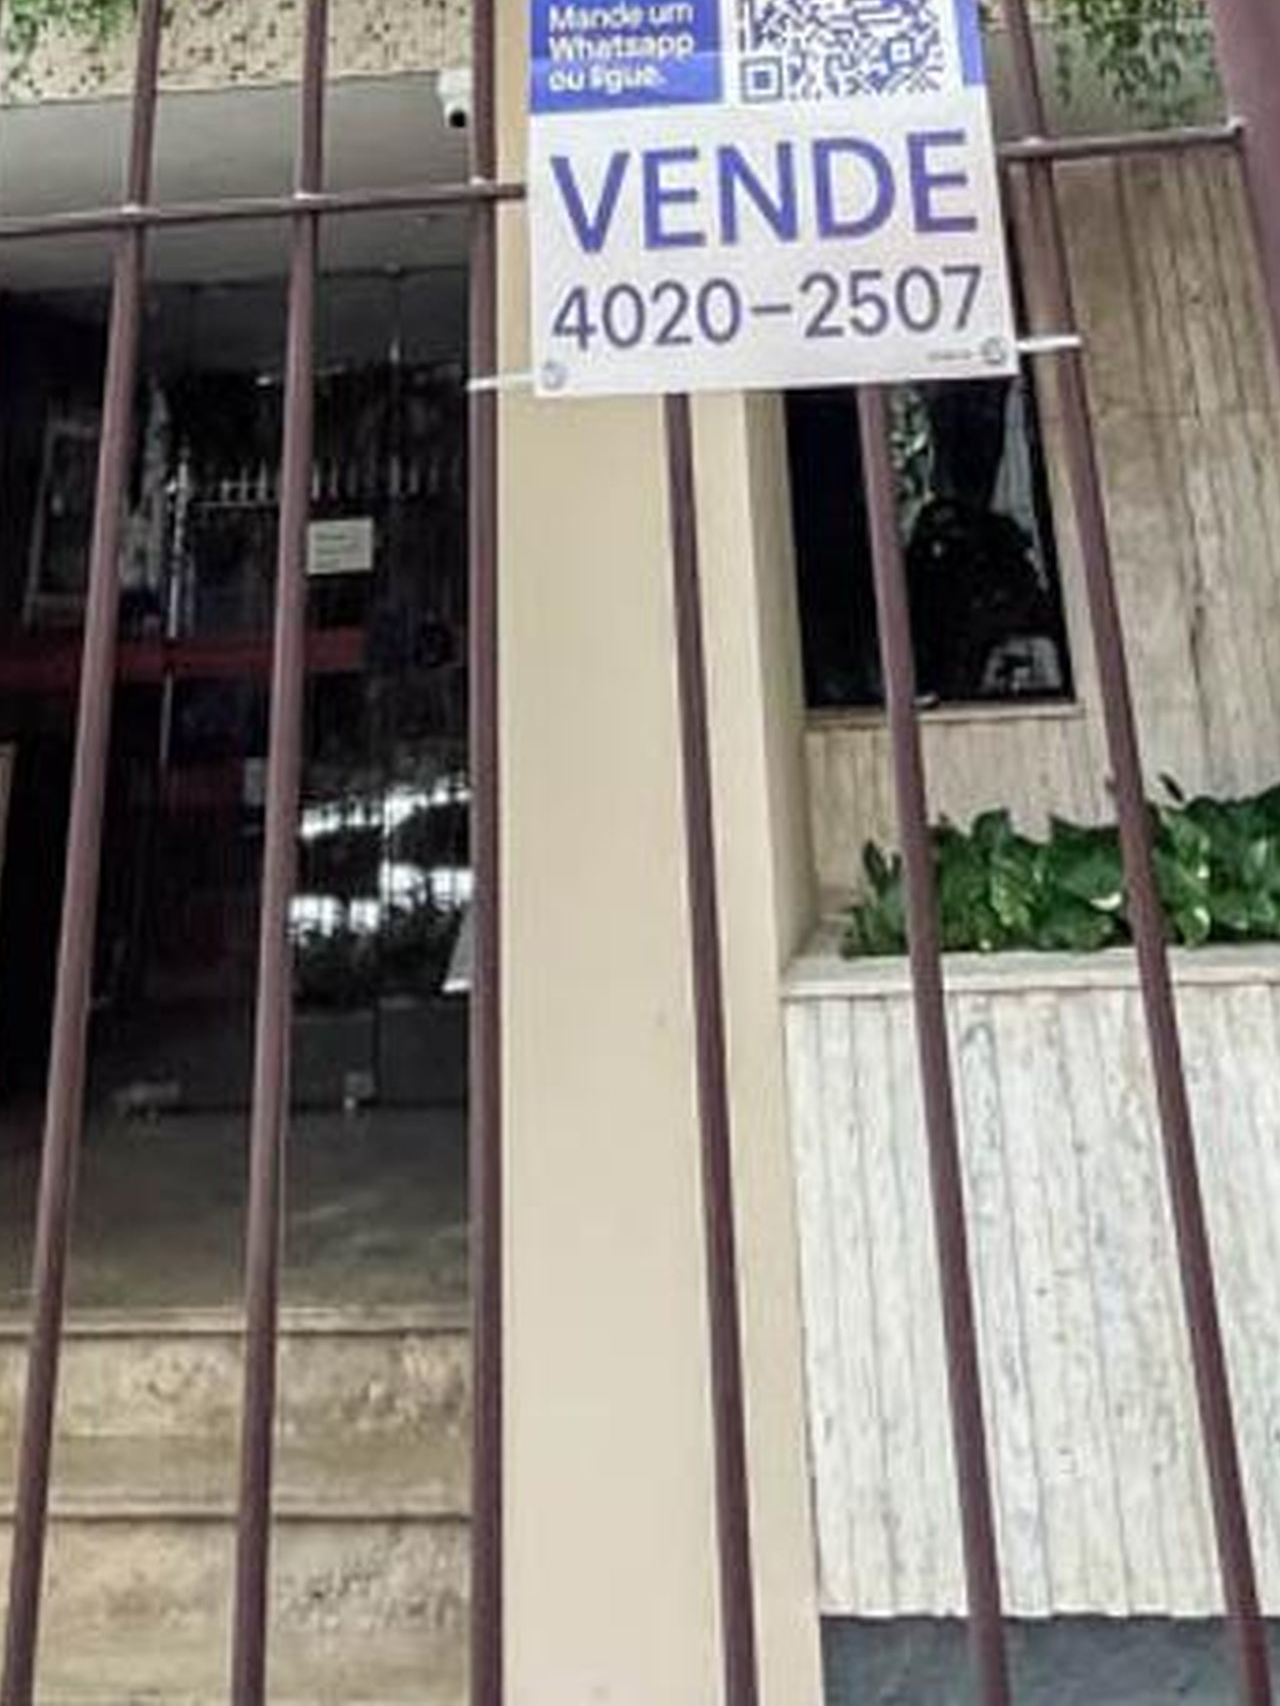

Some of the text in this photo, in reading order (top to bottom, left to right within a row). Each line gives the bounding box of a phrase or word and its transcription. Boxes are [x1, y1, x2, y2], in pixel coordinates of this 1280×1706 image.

[549, 0, 695, 33] Mande um
[549, 70, 585, 92] ou
[550, 130, 979, 254] VENDE
[552, 264, 983, 351] 4020-2507
